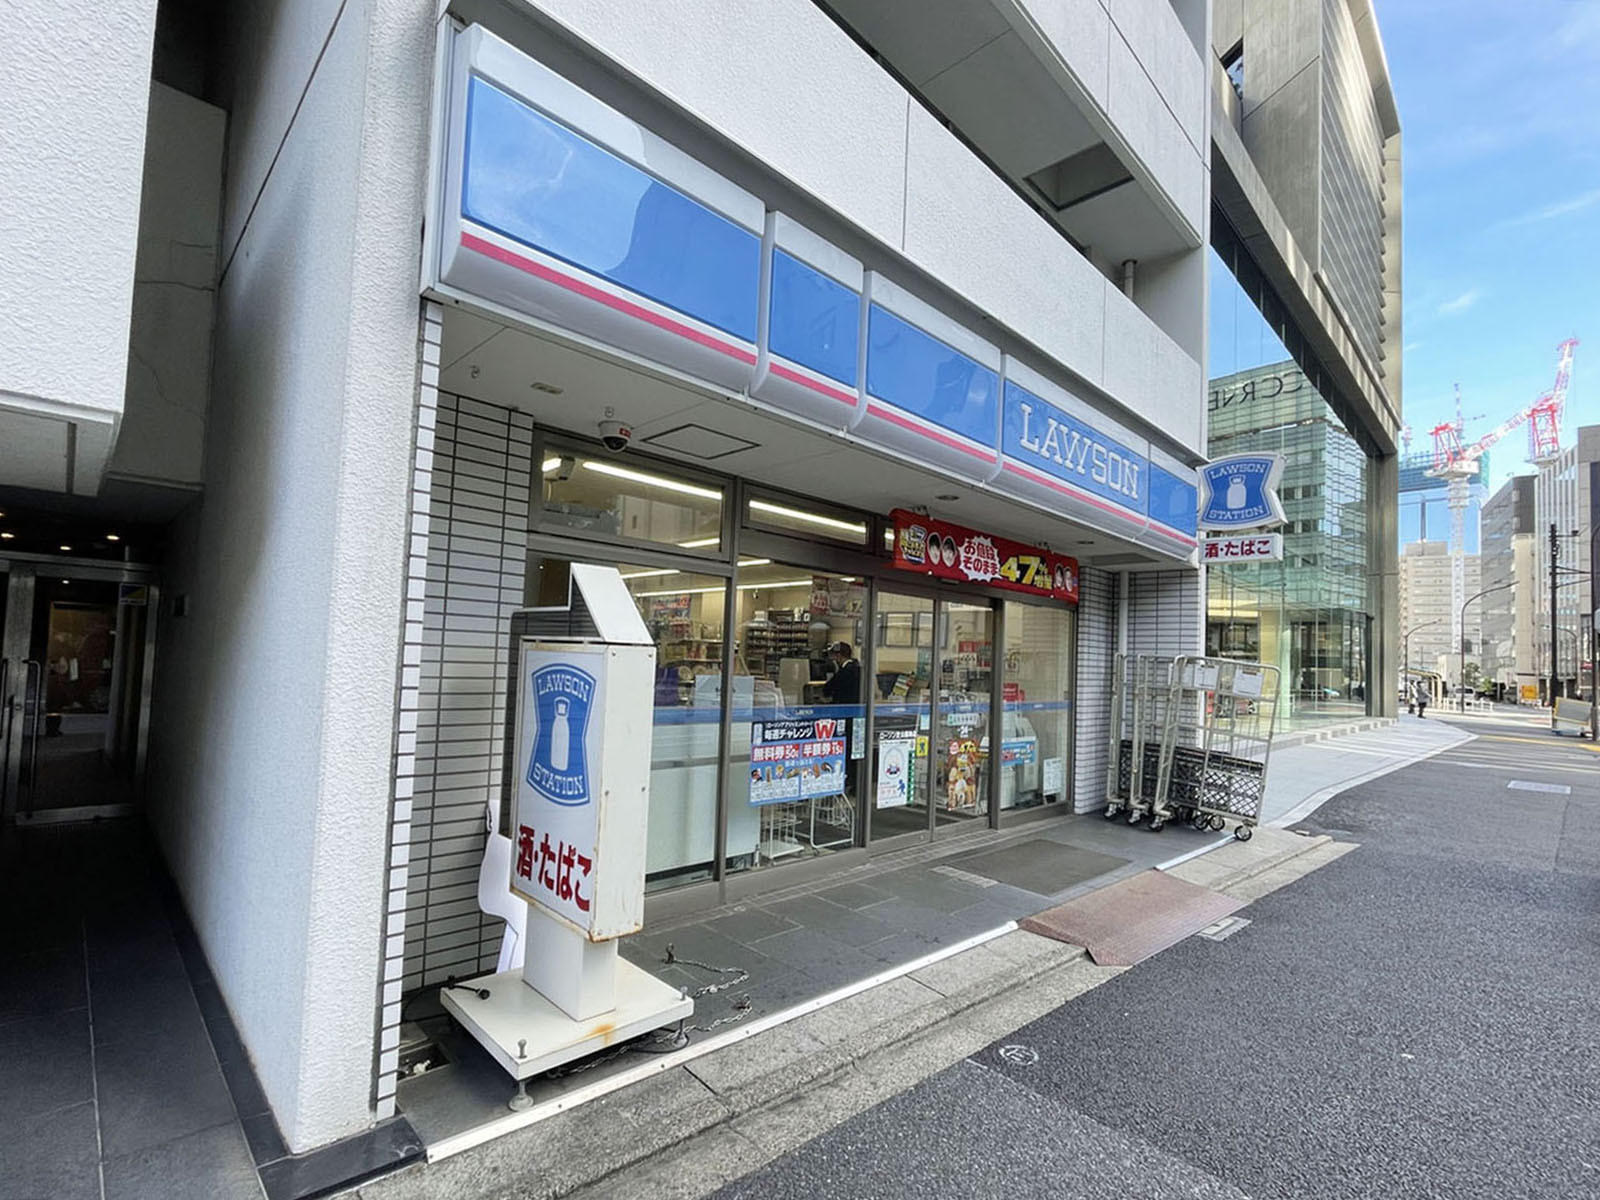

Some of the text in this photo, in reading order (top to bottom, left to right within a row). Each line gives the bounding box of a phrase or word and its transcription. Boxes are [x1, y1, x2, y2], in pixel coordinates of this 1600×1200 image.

[1020, 402, 1139, 500] LAWSON
[1210, 463, 1266, 480] LAWSON
[1208, 505, 1264, 520] STATION
[1205, 540, 1270, 559] 酒・たばこ
[963, 556, 999, 576] そのまま
[538, 674, 591, 702] LAWSON
[532, 762, 584, 796] STATION
[517, 824, 592, 912] 酒・たばこ
